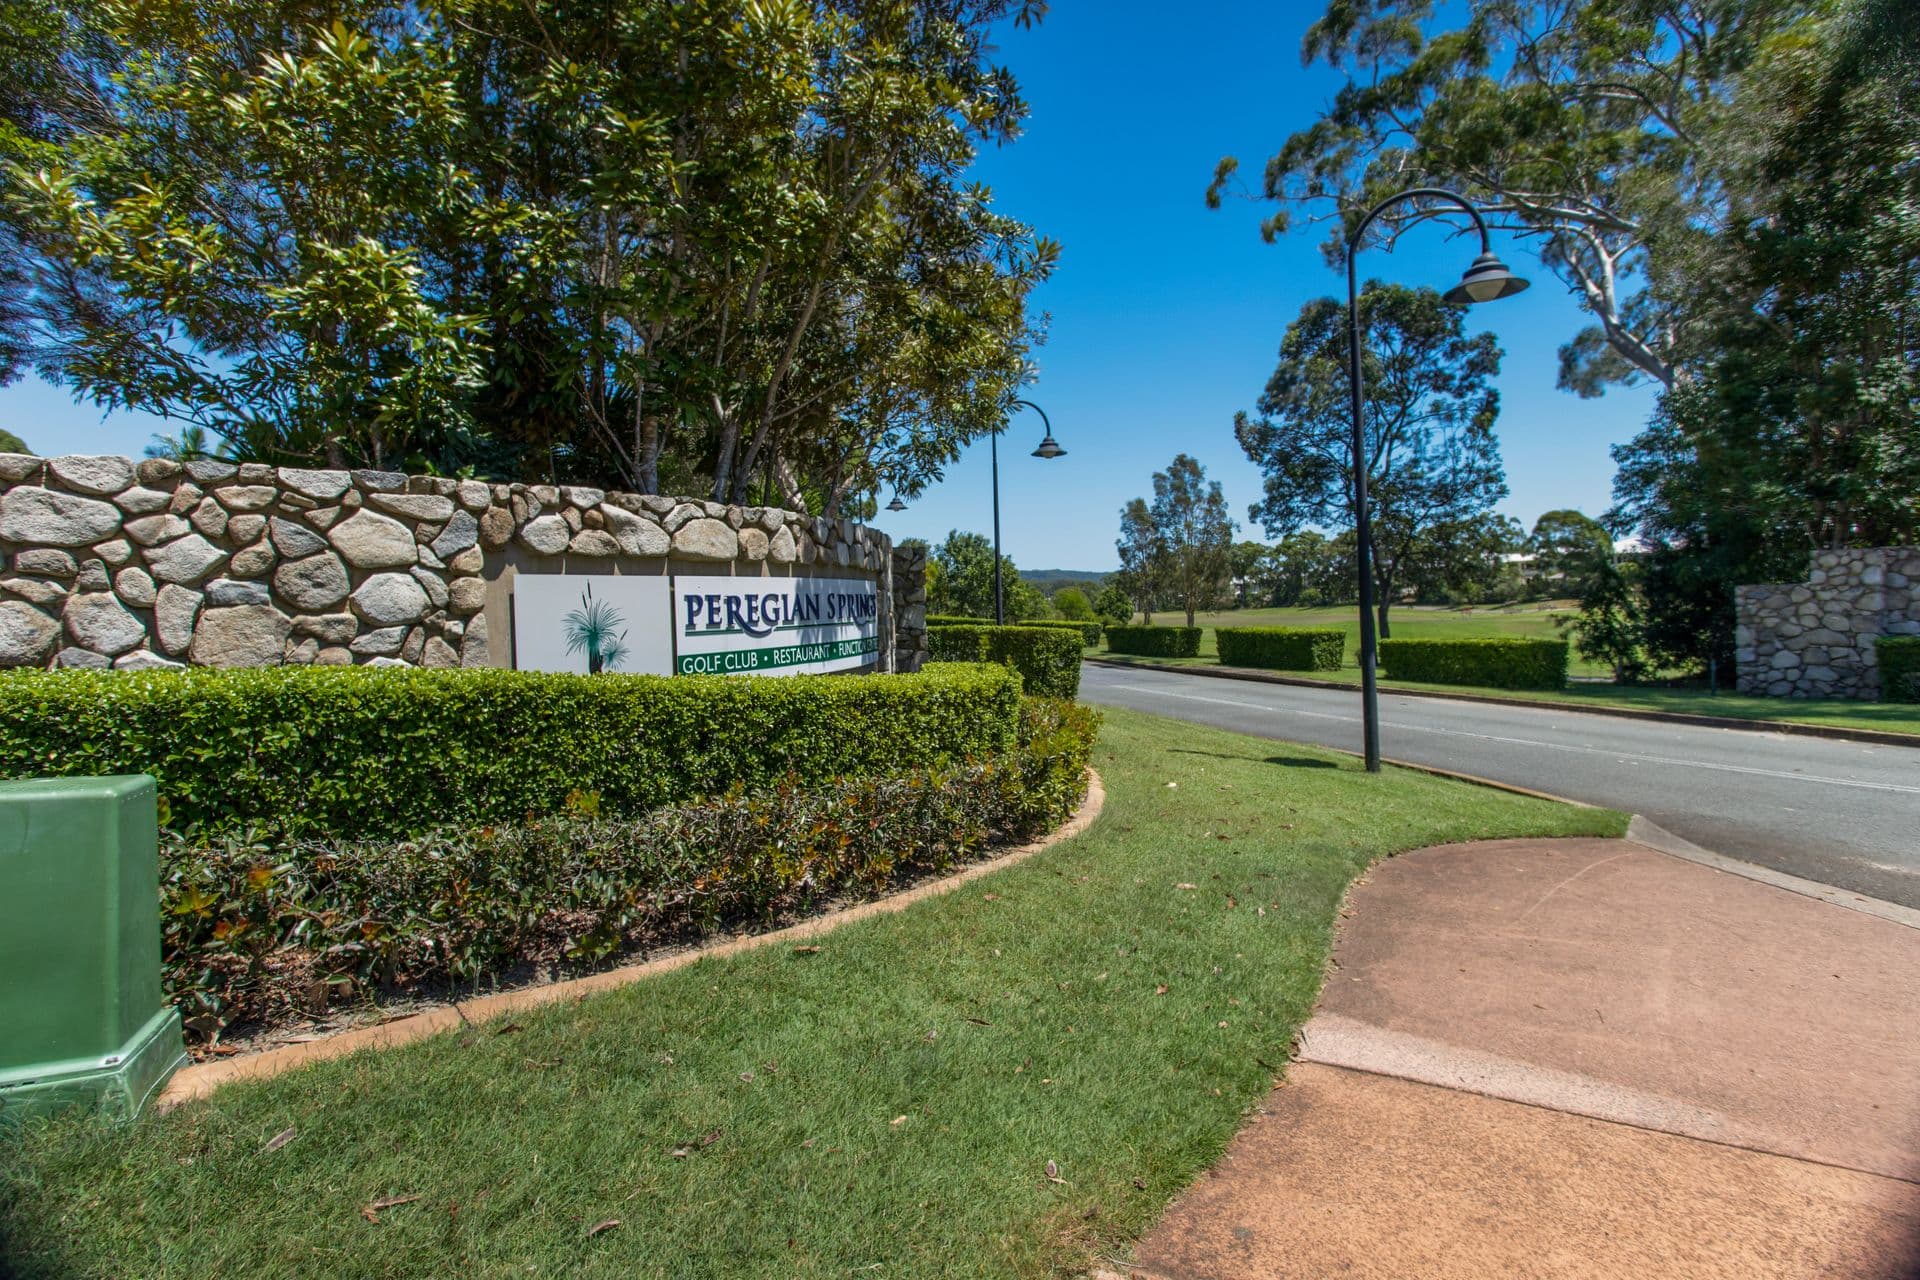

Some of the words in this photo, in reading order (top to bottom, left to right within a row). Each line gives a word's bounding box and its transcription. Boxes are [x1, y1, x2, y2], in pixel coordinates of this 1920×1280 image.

[684, 593, 821, 638] PEREGIAN
[827, 592, 877, 625] SPRINGS
[682, 654, 721, 675] GOLF
[724, 651, 759, 670] CLUB
[773, 644, 830, 665] RESTAURANT
